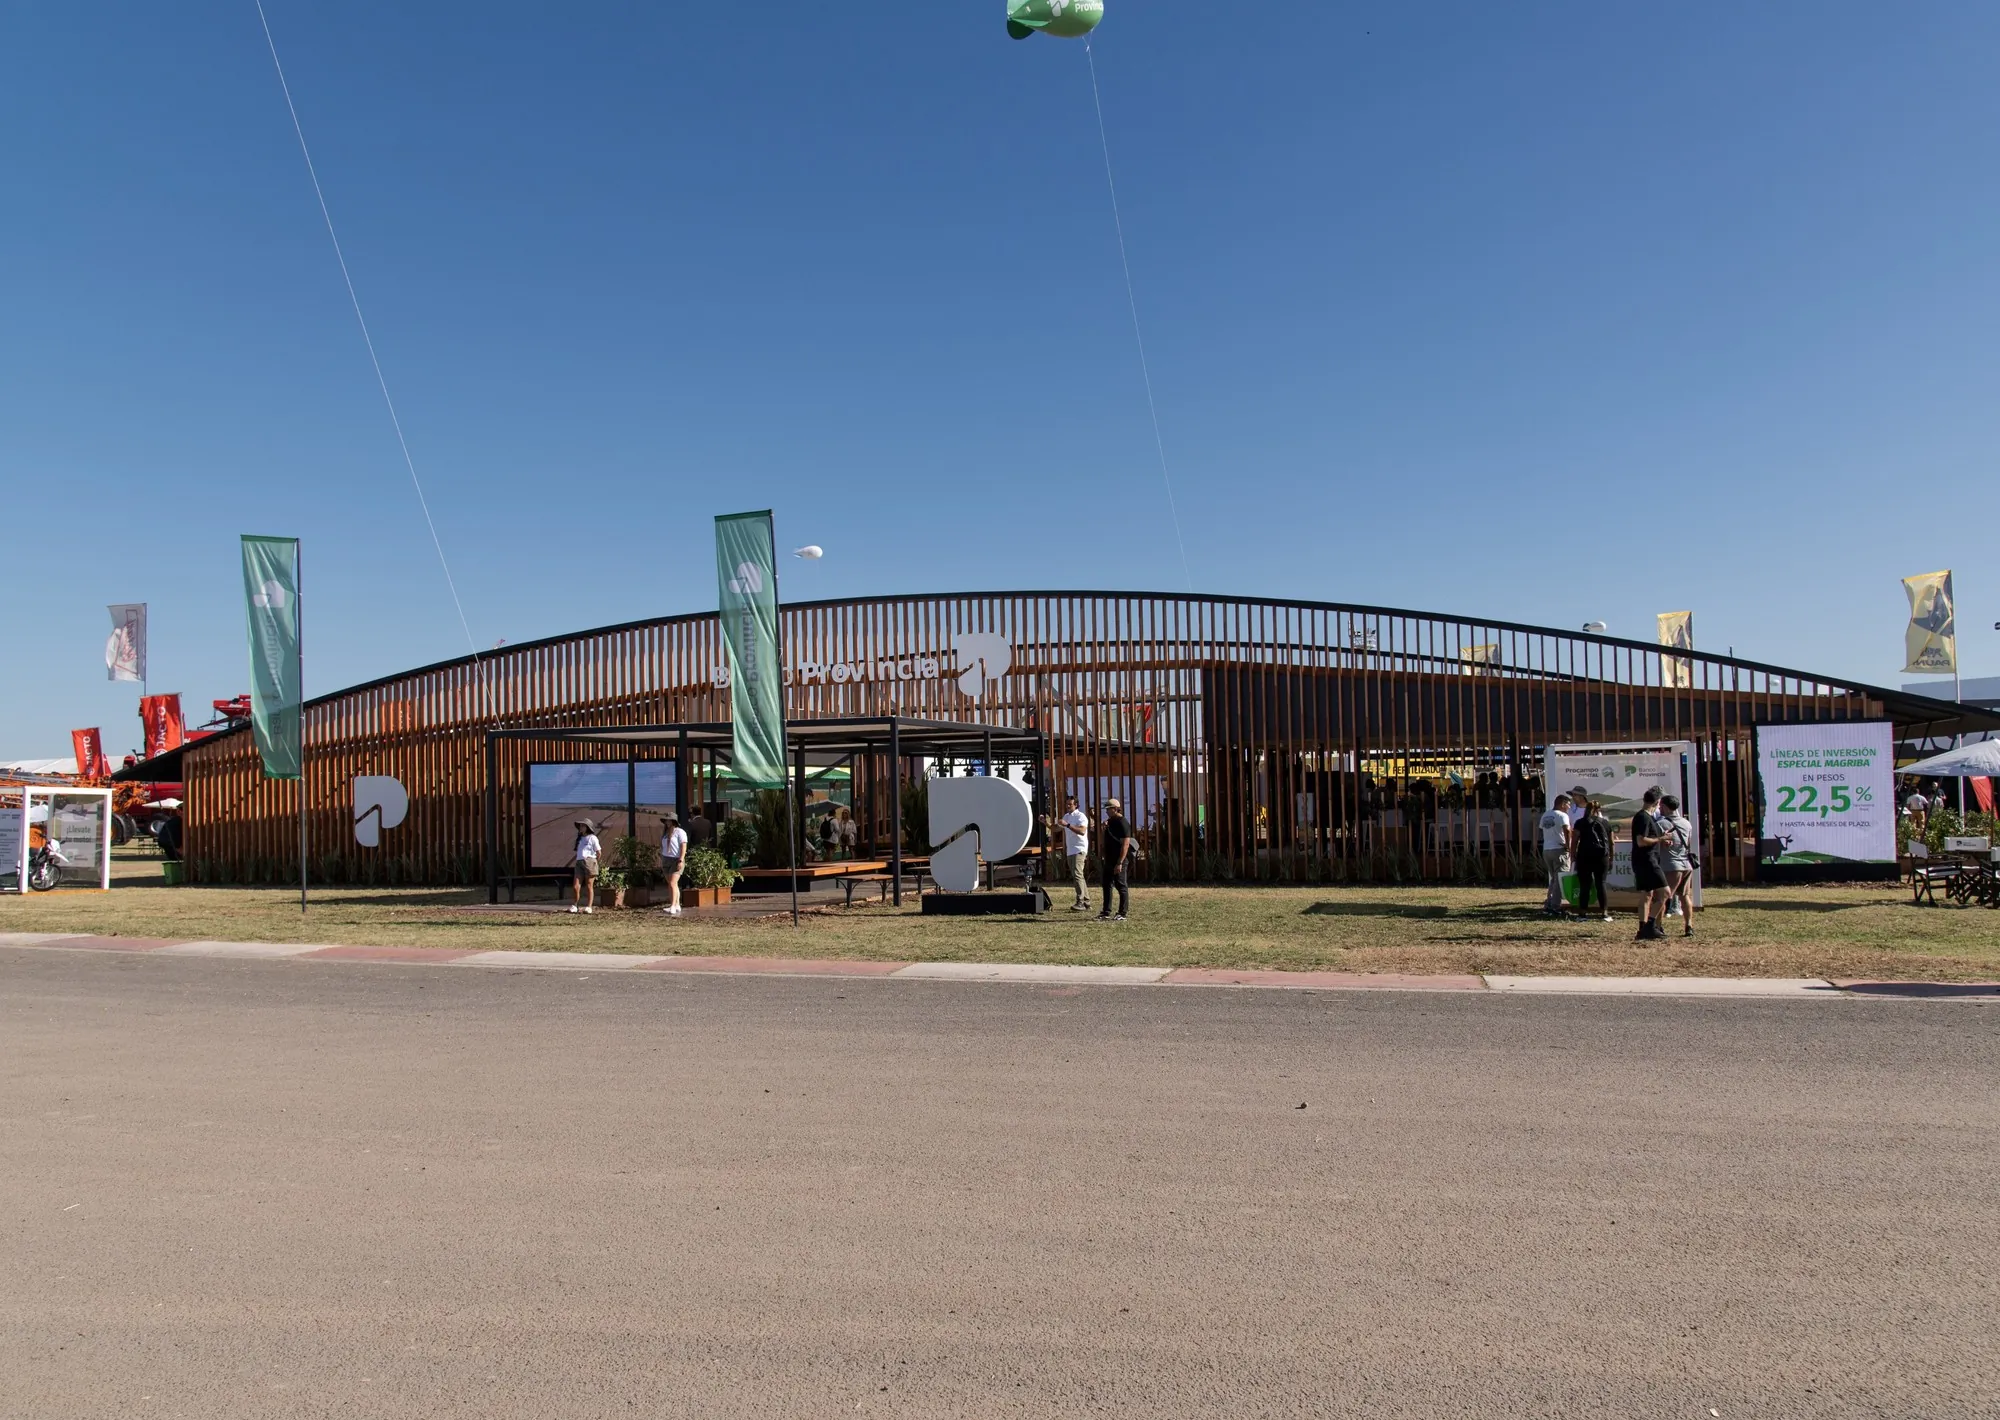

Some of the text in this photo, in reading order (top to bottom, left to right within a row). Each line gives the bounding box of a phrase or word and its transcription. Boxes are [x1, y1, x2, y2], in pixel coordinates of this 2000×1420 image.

[801, 656, 939, 685] Provincia
[156, 706, 166, 747] JACTO
[82, 735, 93, 765] JACTO
[1770, 749, 1804, 758] LÍNEAS
[1823, 747, 1876, 757] INVERSIÓN
[1777, 759, 1870, 768] ESPECIAL MAGRIBA
